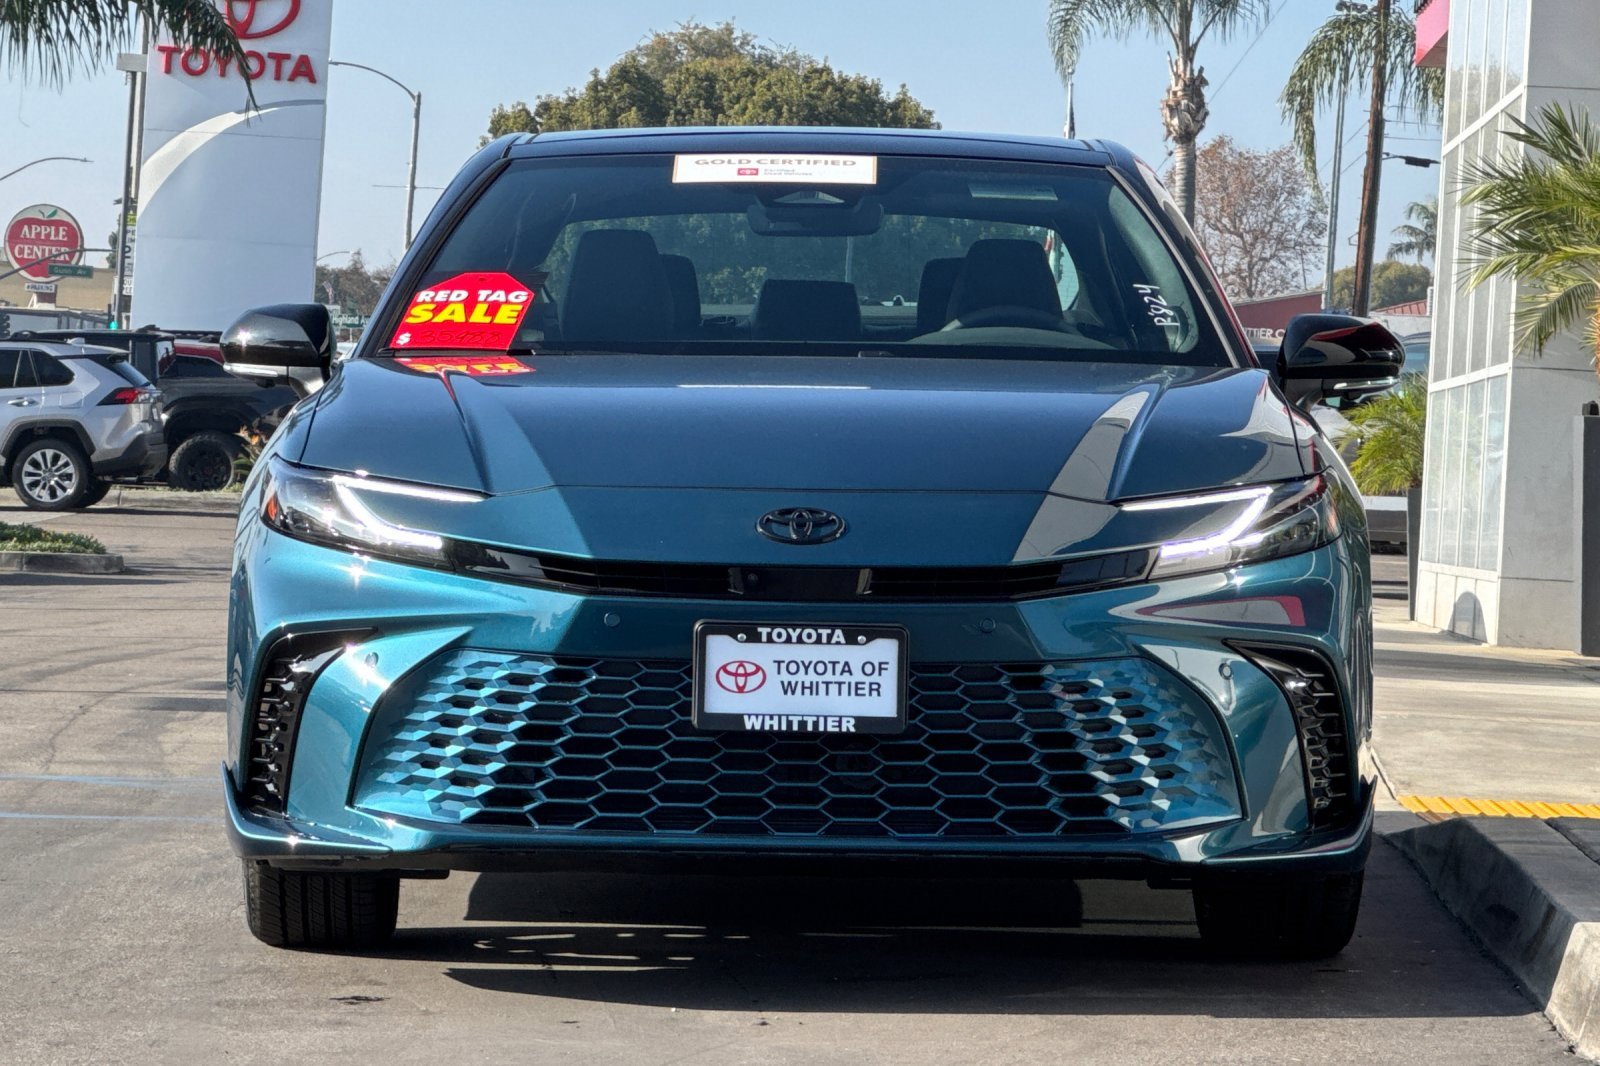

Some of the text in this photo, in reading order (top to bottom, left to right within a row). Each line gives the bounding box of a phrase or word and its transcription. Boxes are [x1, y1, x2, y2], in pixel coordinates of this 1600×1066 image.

[157, 45, 317, 84] TOYOTA
[695, 158, 857, 167] GOLD CERTIFIED
[20, 224, 68, 241] APPLE
[14, 244, 70, 261] CENTER
[416, 290, 528, 303] RED TAG
[404, 303, 523, 324] SALE
[757, 627, 846, 644] TOYOTA
[773, 660, 889, 676] TOYOTA OF
[780, 680, 881, 697] WHITTIER
[743, 715, 856, 732] WHITTIER
